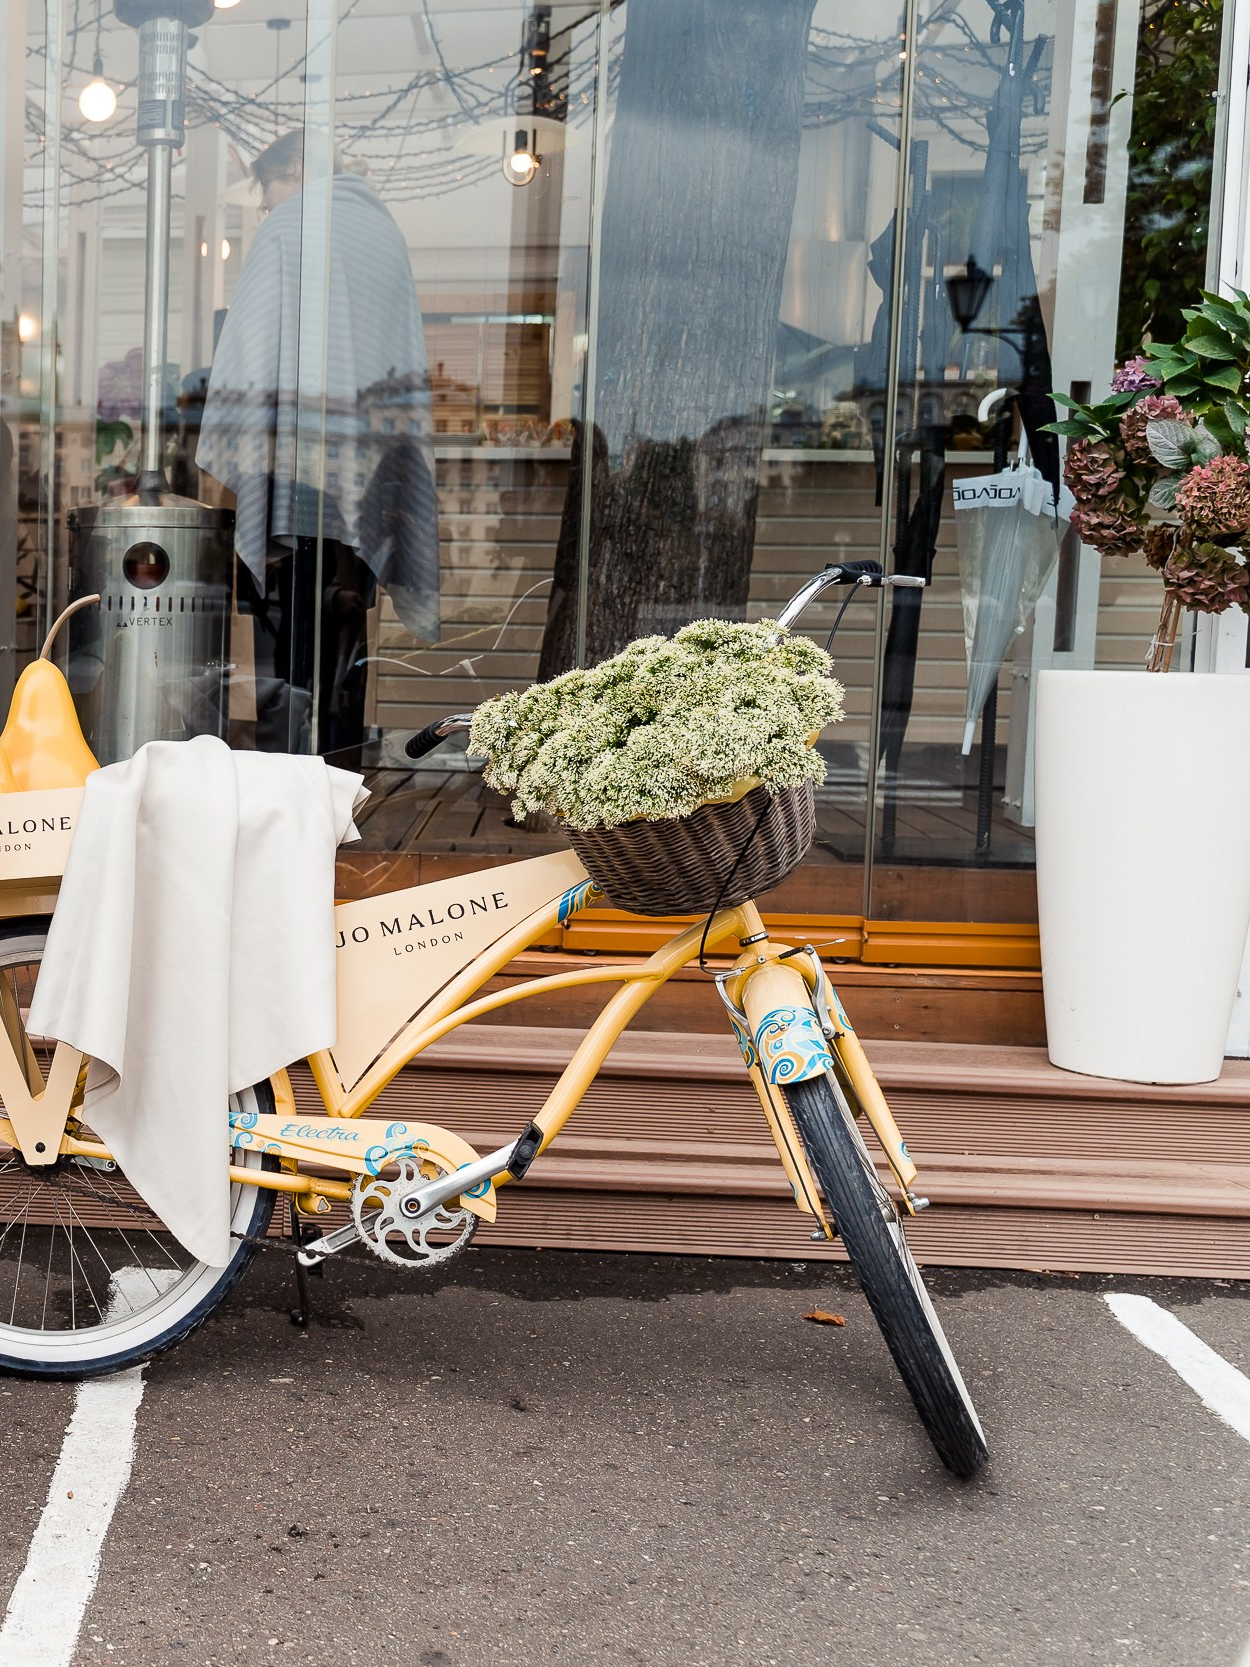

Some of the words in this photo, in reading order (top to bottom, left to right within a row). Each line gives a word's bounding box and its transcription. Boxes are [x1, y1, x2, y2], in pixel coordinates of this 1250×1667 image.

[128, 616, 173, 627] VERTEX
[335, 926, 370, 949] JO
[379, 891, 509, 937] MALONE
[393, 931, 464, 956] LONDON
[279, 1123, 360, 1141] Electra
